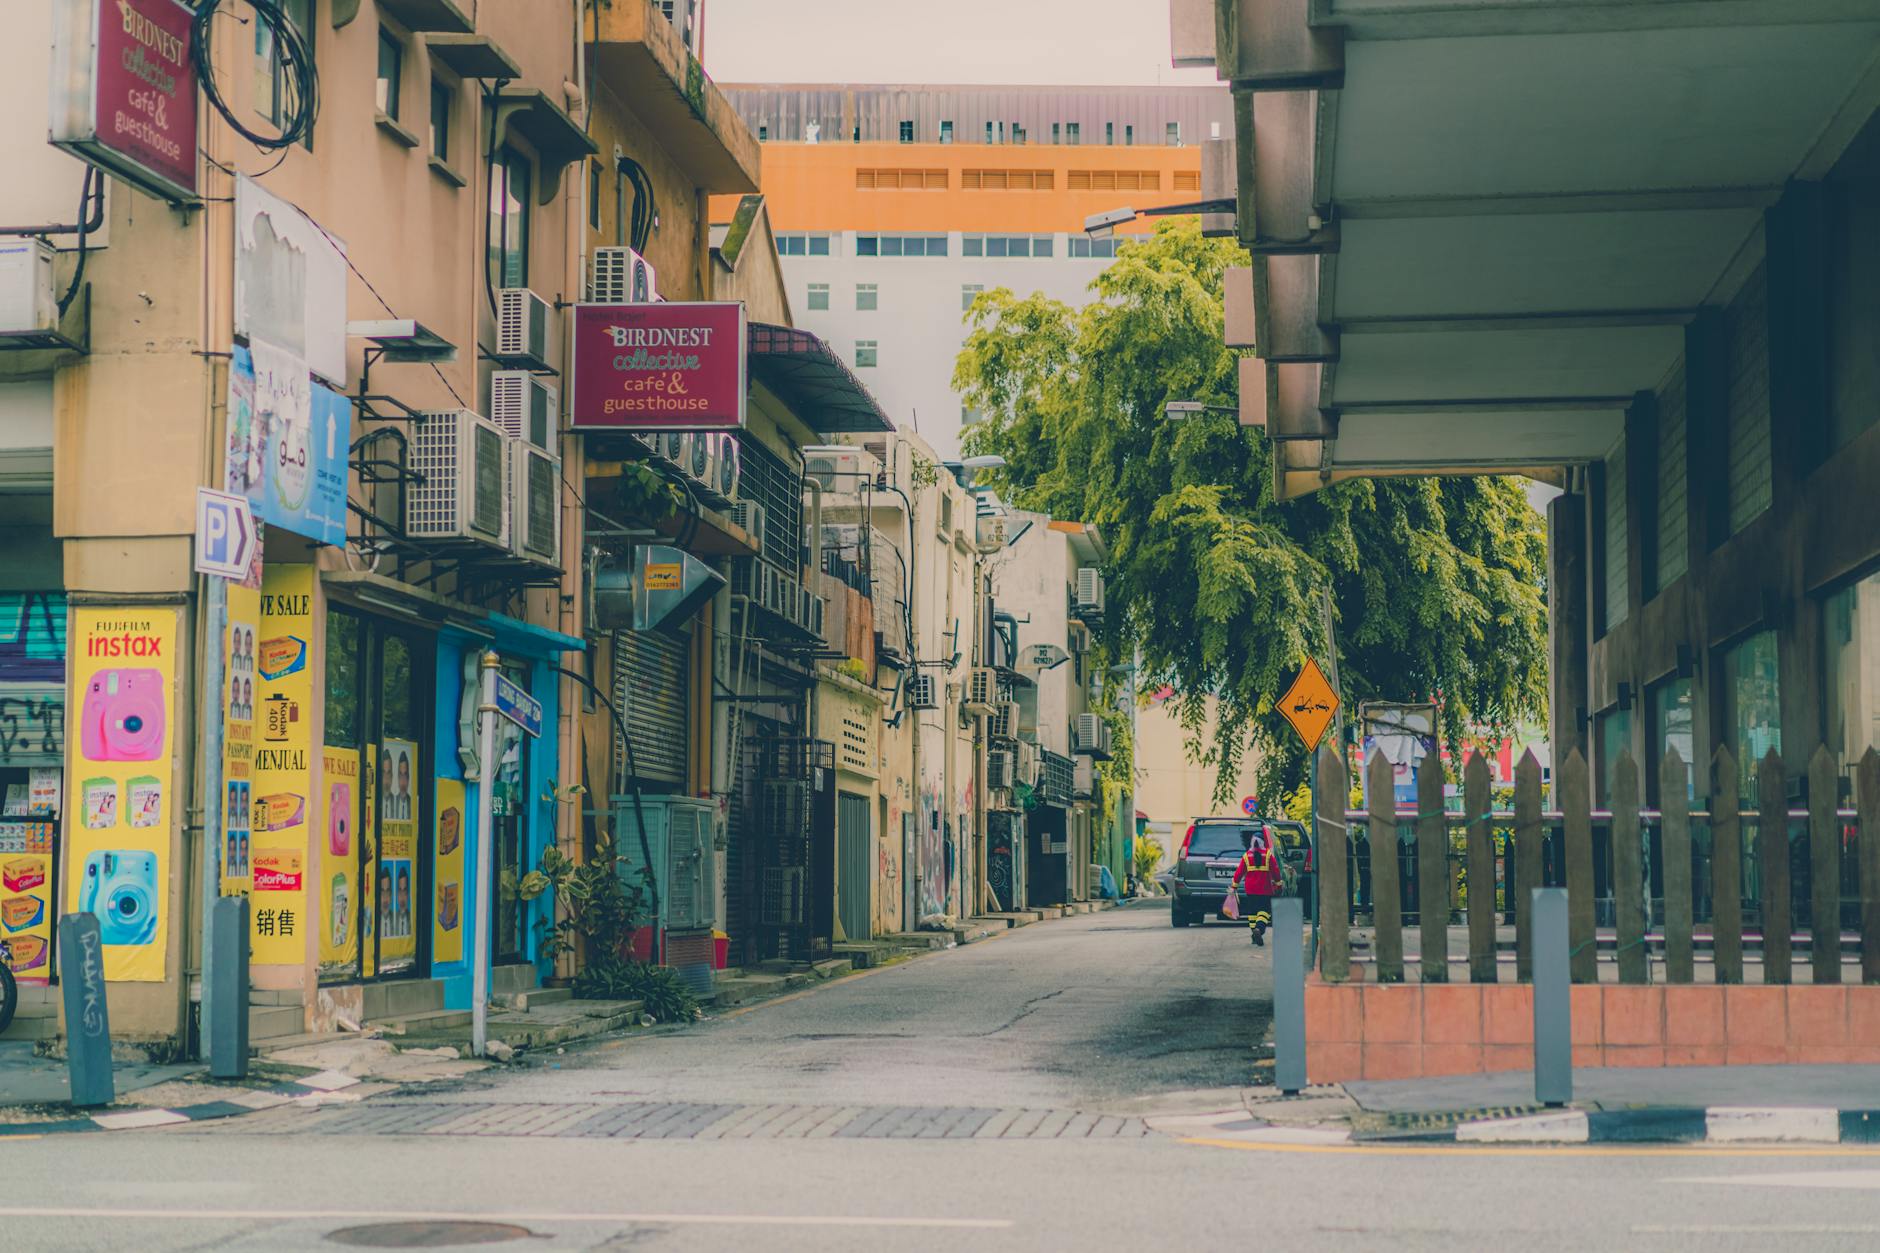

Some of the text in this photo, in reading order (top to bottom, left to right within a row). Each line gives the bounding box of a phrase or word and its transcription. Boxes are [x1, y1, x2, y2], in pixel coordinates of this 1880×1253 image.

[122, 5, 183, 67] BIRDNEST
[121, 44, 176, 98] collective
[155, 95, 169, 130] &
[115, 110, 180, 160] guesthouse
[613, 327, 713, 347] BIRDNEST
[612, 348, 701, 371] collective
[667, 372, 689, 394] &
[603, 396, 709, 414] guesthouse
[207, 508, 226, 556] P
[277, 595, 309, 616] SALE
[96, 621, 151, 631] FUJIFILM
[87, 632, 162, 657] instax
[269, 708, 278, 731] 400
[280, 702, 288, 736] Kodak
[227, 742, 252, 759] PASSPORT
[323, 757, 356, 777] WE SALE
[256, 908, 295, 937] 销售
